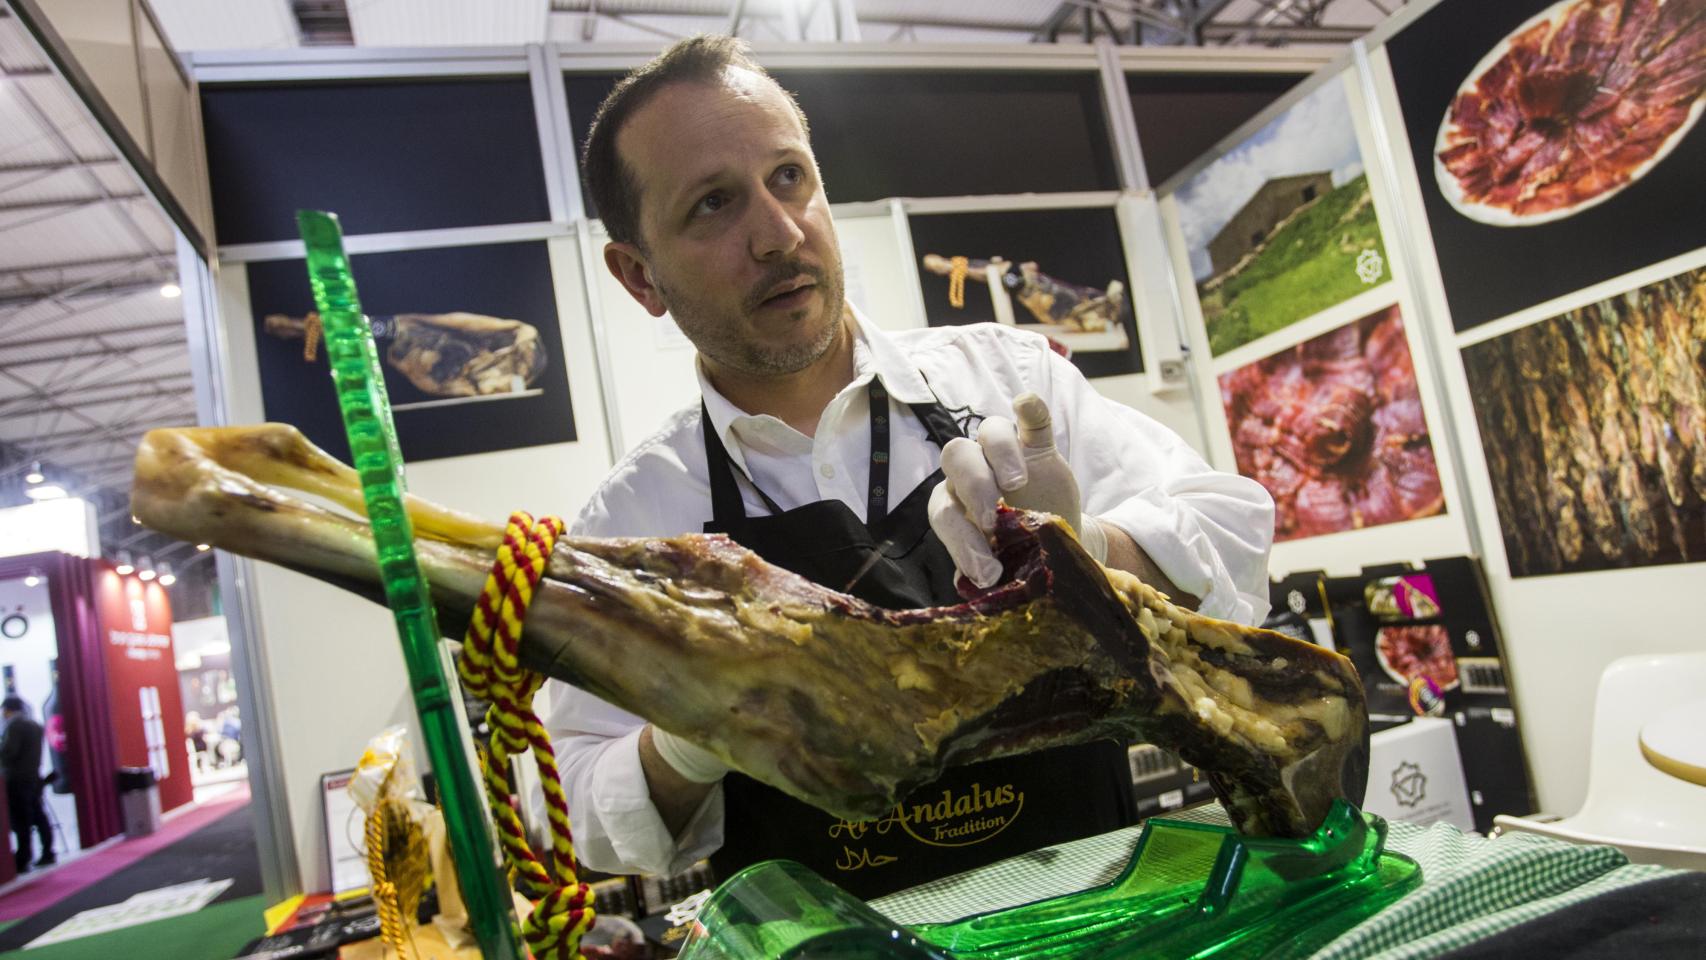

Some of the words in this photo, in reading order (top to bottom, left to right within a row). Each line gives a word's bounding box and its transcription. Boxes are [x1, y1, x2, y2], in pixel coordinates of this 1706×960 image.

[877, 783, 1016, 837] Andalus
[932, 816, 1006, 841] Tradition
[835, 845, 898, 870] حلال
